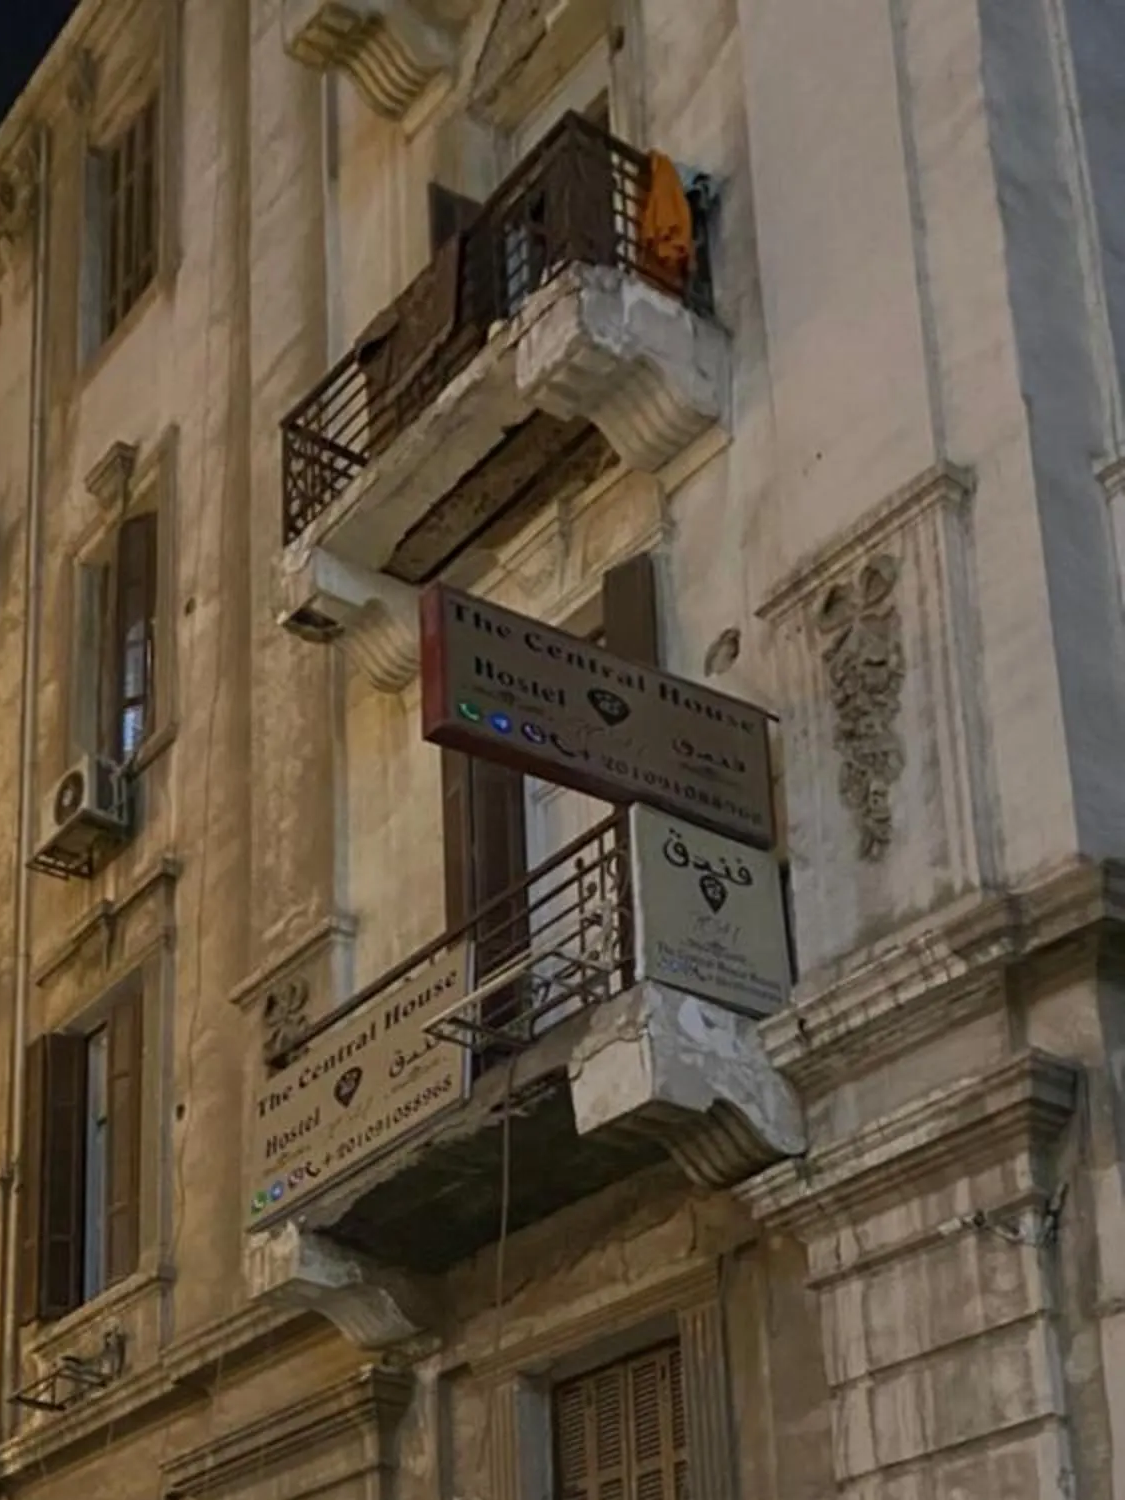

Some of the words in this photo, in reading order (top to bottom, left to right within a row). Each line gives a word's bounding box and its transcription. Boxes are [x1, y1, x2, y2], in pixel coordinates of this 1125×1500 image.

[452, 601, 512, 639] The
[524, 627, 645, 690] Central
[659, 679, 756, 735] House
[474, 655, 567, 707] Hostel
[663, 827, 753, 887] فندق
[256, 1085, 294, 1118] The
[297, 1021, 377, 1091] Central
[383, 968, 459, 1031] House
[265, 1106, 321, 1159] Hostel
